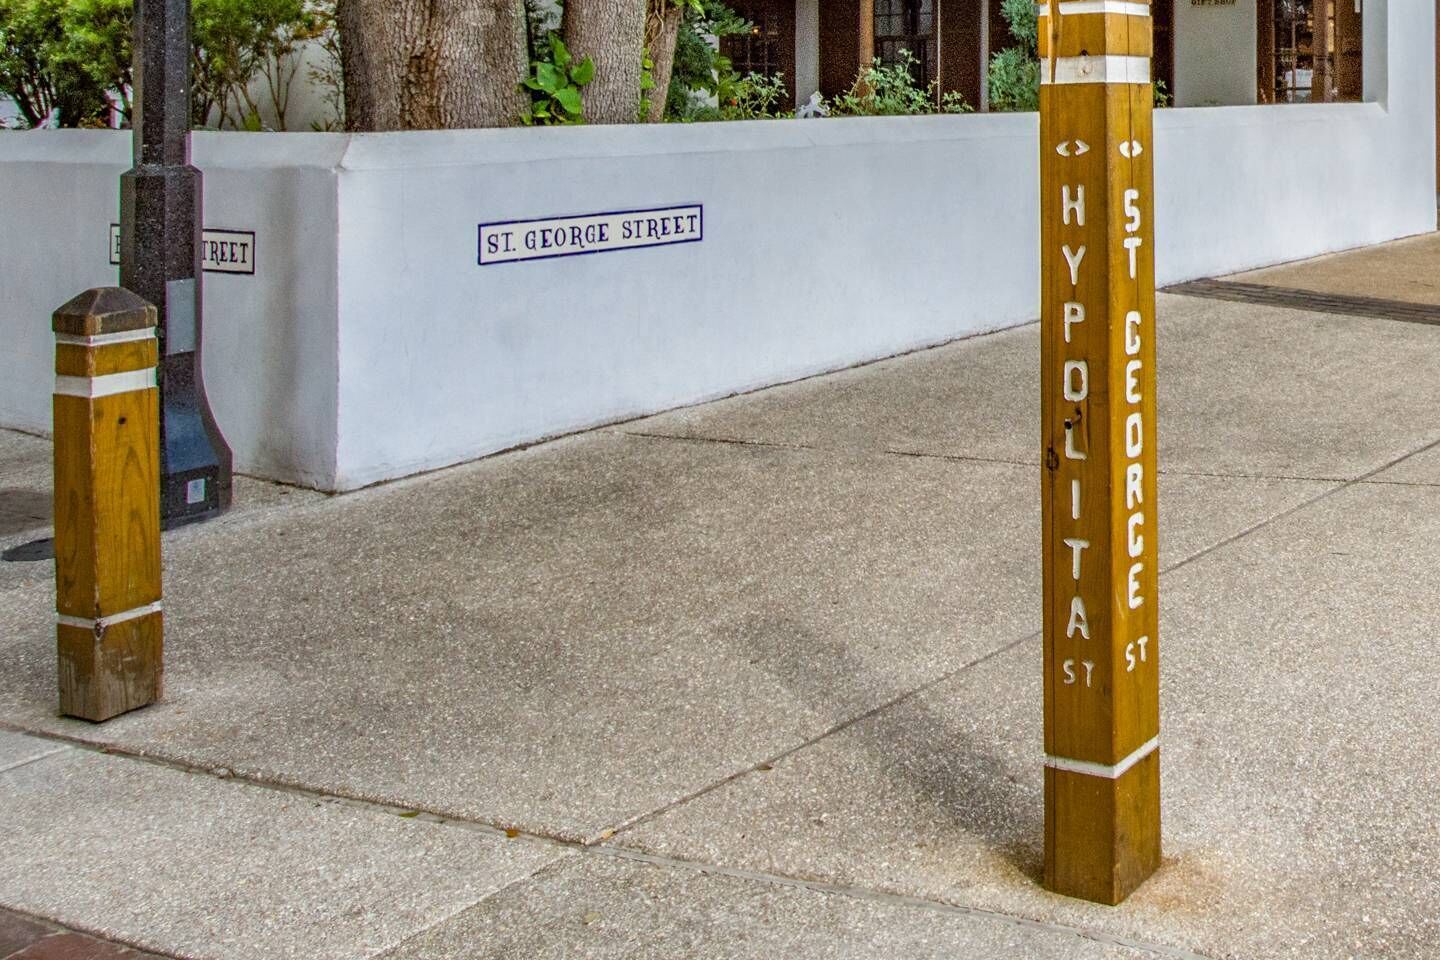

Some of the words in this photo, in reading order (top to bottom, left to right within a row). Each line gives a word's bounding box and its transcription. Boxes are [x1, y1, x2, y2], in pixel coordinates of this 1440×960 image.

[202, 240, 249, 266] TREET
[487, 231, 517, 255] ST.
[524, 222, 610, 251] GEORGE
[621, 214, 698, 241] STREET
[1123, 188, 1143, 280] ST
[1061, 183, 1091, 640] HYPOLITA
[1125, 310, 1145, 610] GEORGE
[1063, 659, 1095, 688] ST
[1125, 635, 1149, 673] ST
